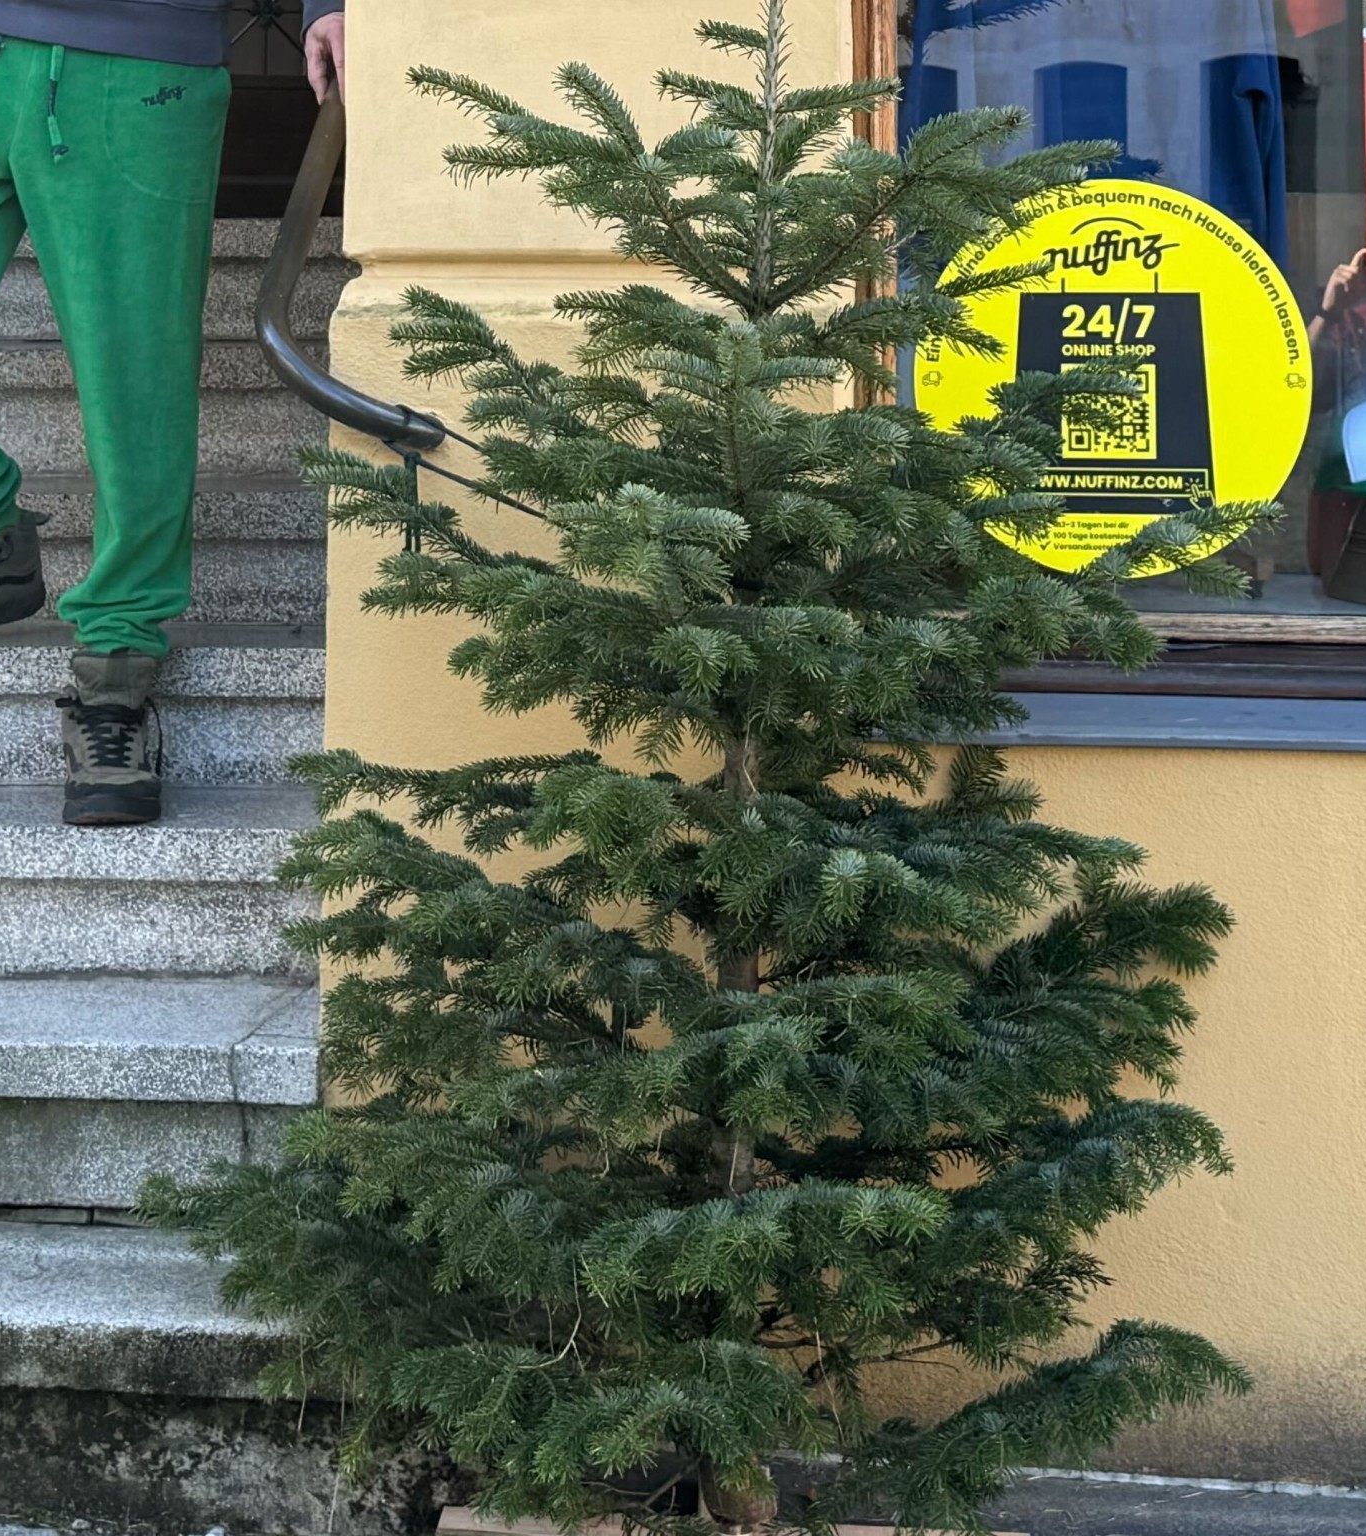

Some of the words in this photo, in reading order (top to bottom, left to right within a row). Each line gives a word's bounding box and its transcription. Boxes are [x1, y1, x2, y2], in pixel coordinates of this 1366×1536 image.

[1042, 230, 1180, 276] nuffinz
[958, 252, 986, 279] line
[1072, 192, 1145, 207] bequem
[1149, 197, 1193, 220] nach
[1194, 212, 1243, 253] Hause
[1241, 249, 1280, 302] liefern
[1275, 302, 1300, 365] lassen.
[1062, 298, 1155, 344] 24/7
[1062, 344, 1113, 356] ONLINE
[1115, 344, 1156, 356] SHOP
[1039, 475, 1183, 489] WW.NUFFINZ.COM
